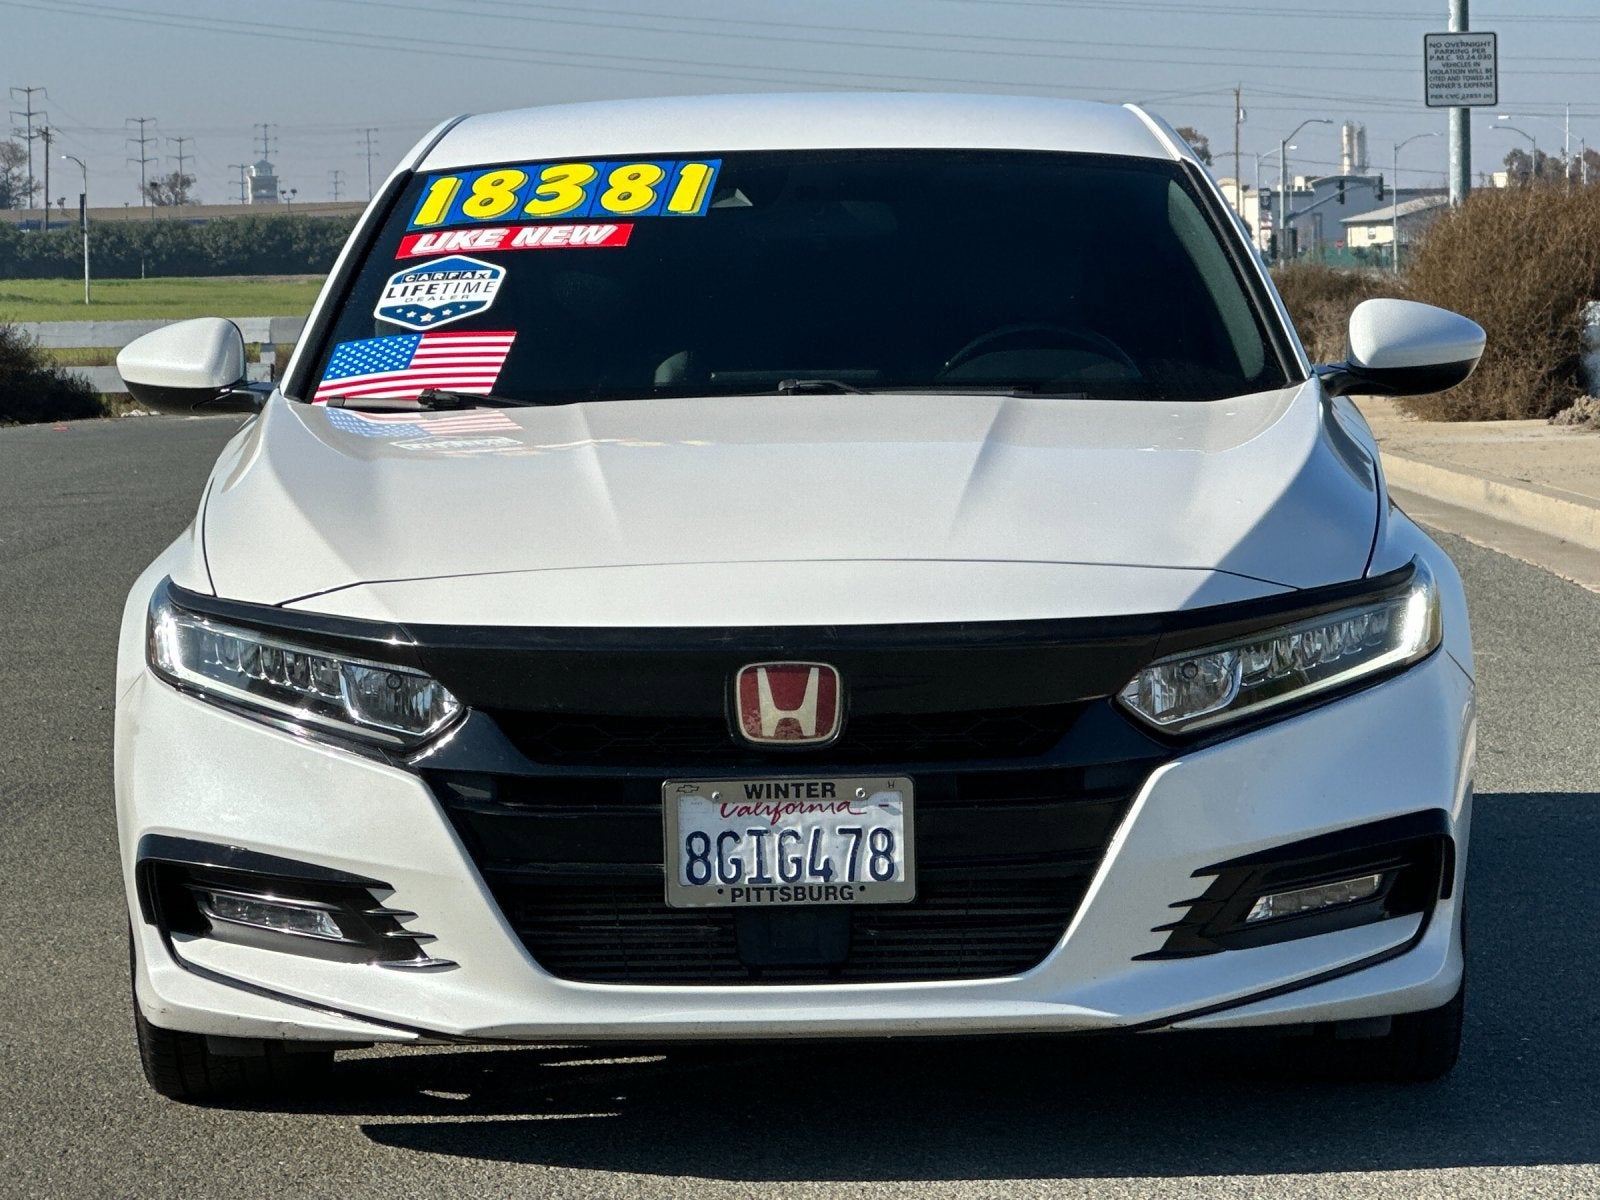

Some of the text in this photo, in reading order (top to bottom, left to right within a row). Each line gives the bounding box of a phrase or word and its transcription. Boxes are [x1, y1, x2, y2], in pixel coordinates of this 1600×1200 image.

[413, 162, 715, 226] 18381
[411, 224, 618, 254] LIKE NEW
[402, 269, 493, 283] CARFAX
[386, 280, 497, 299] LIFETIME
[404, 294, 470, 303] DEALER
[744, 782, 836, 800] WINTER
[720, 800, 867, 826] California
[685, 826, 895, 886] 8GIG478
[730, 885, 854, 903] PITTSBURG
